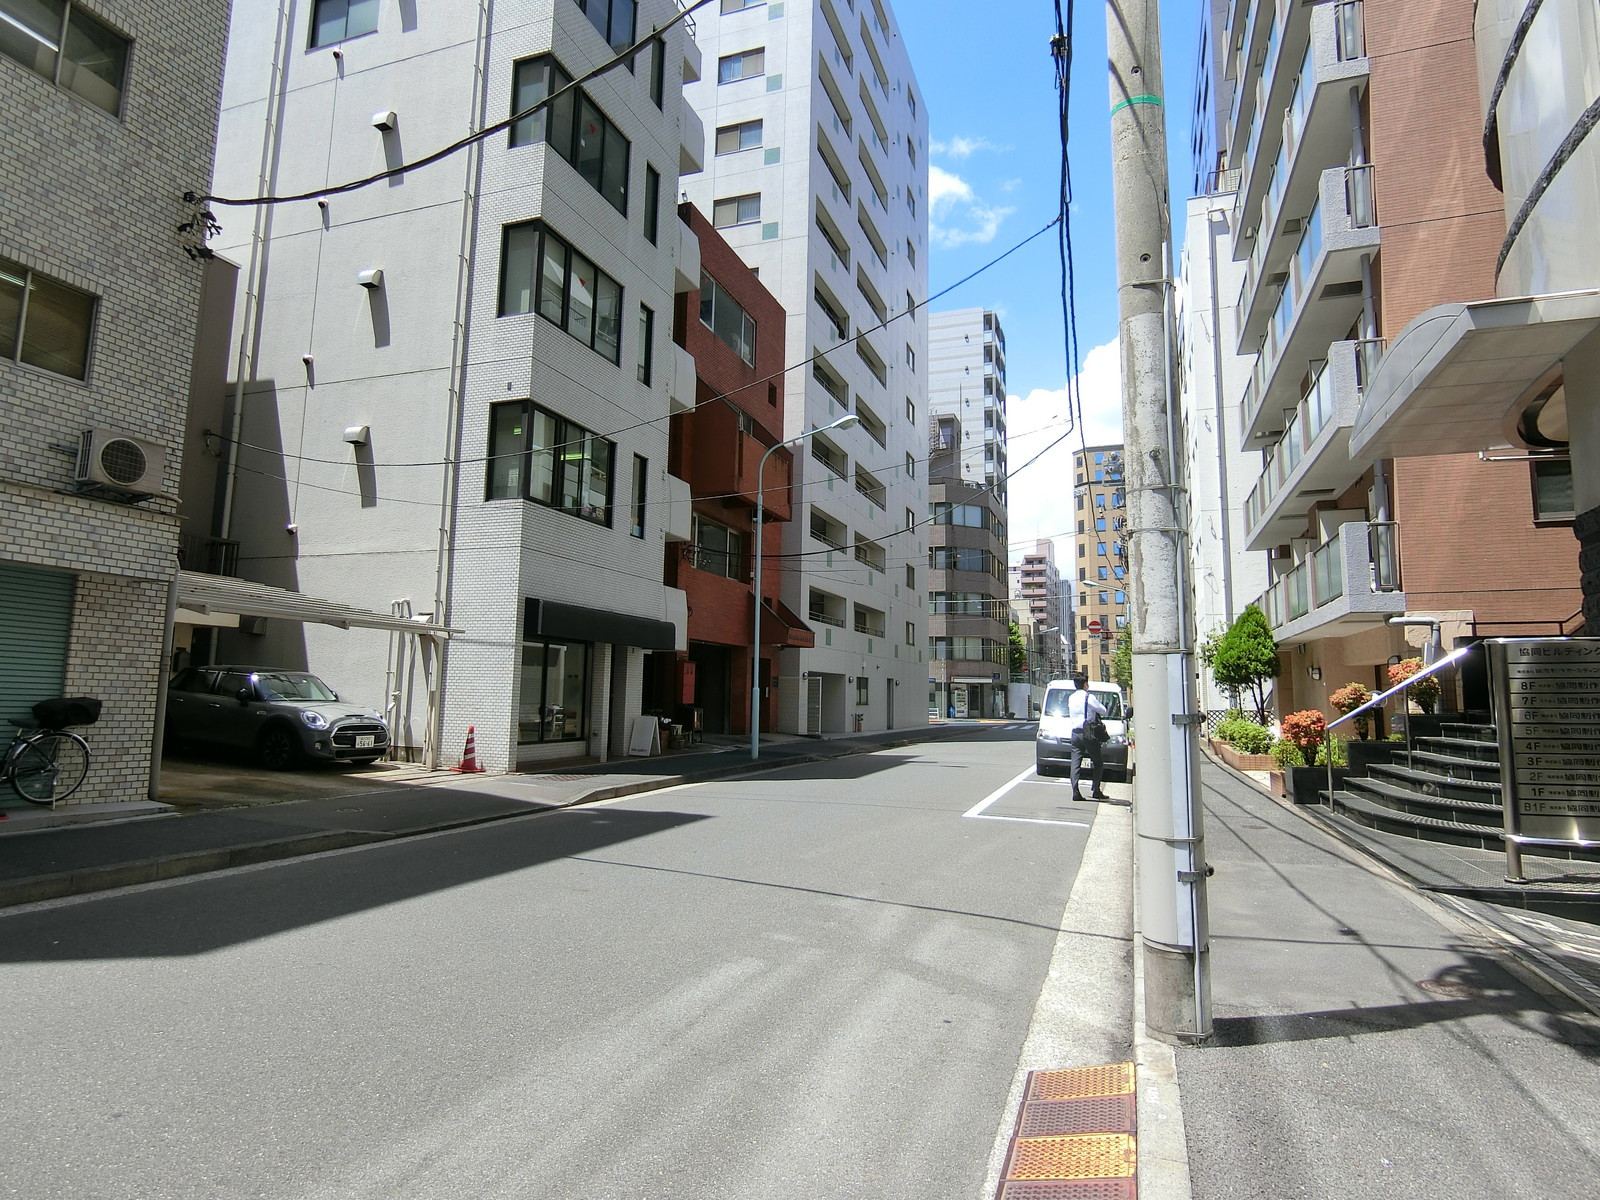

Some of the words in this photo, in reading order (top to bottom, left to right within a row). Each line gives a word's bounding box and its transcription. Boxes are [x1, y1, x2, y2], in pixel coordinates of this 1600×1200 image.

[1521, 681, 1536, 690] 8F
[1522, 696, 1537, 705] 7F
[1524, 711, 1539, 720] 6F
[1525, 726, 1540, 735] 5F
[1525, 742, 1541, 750] 4F
[1527, 757, 1542, 766] 3F
[1529, 772, 1543, 781] 2F
[1531, 787, 1545, 796] 1F
[1524, 802, 1546, 811] B1F
